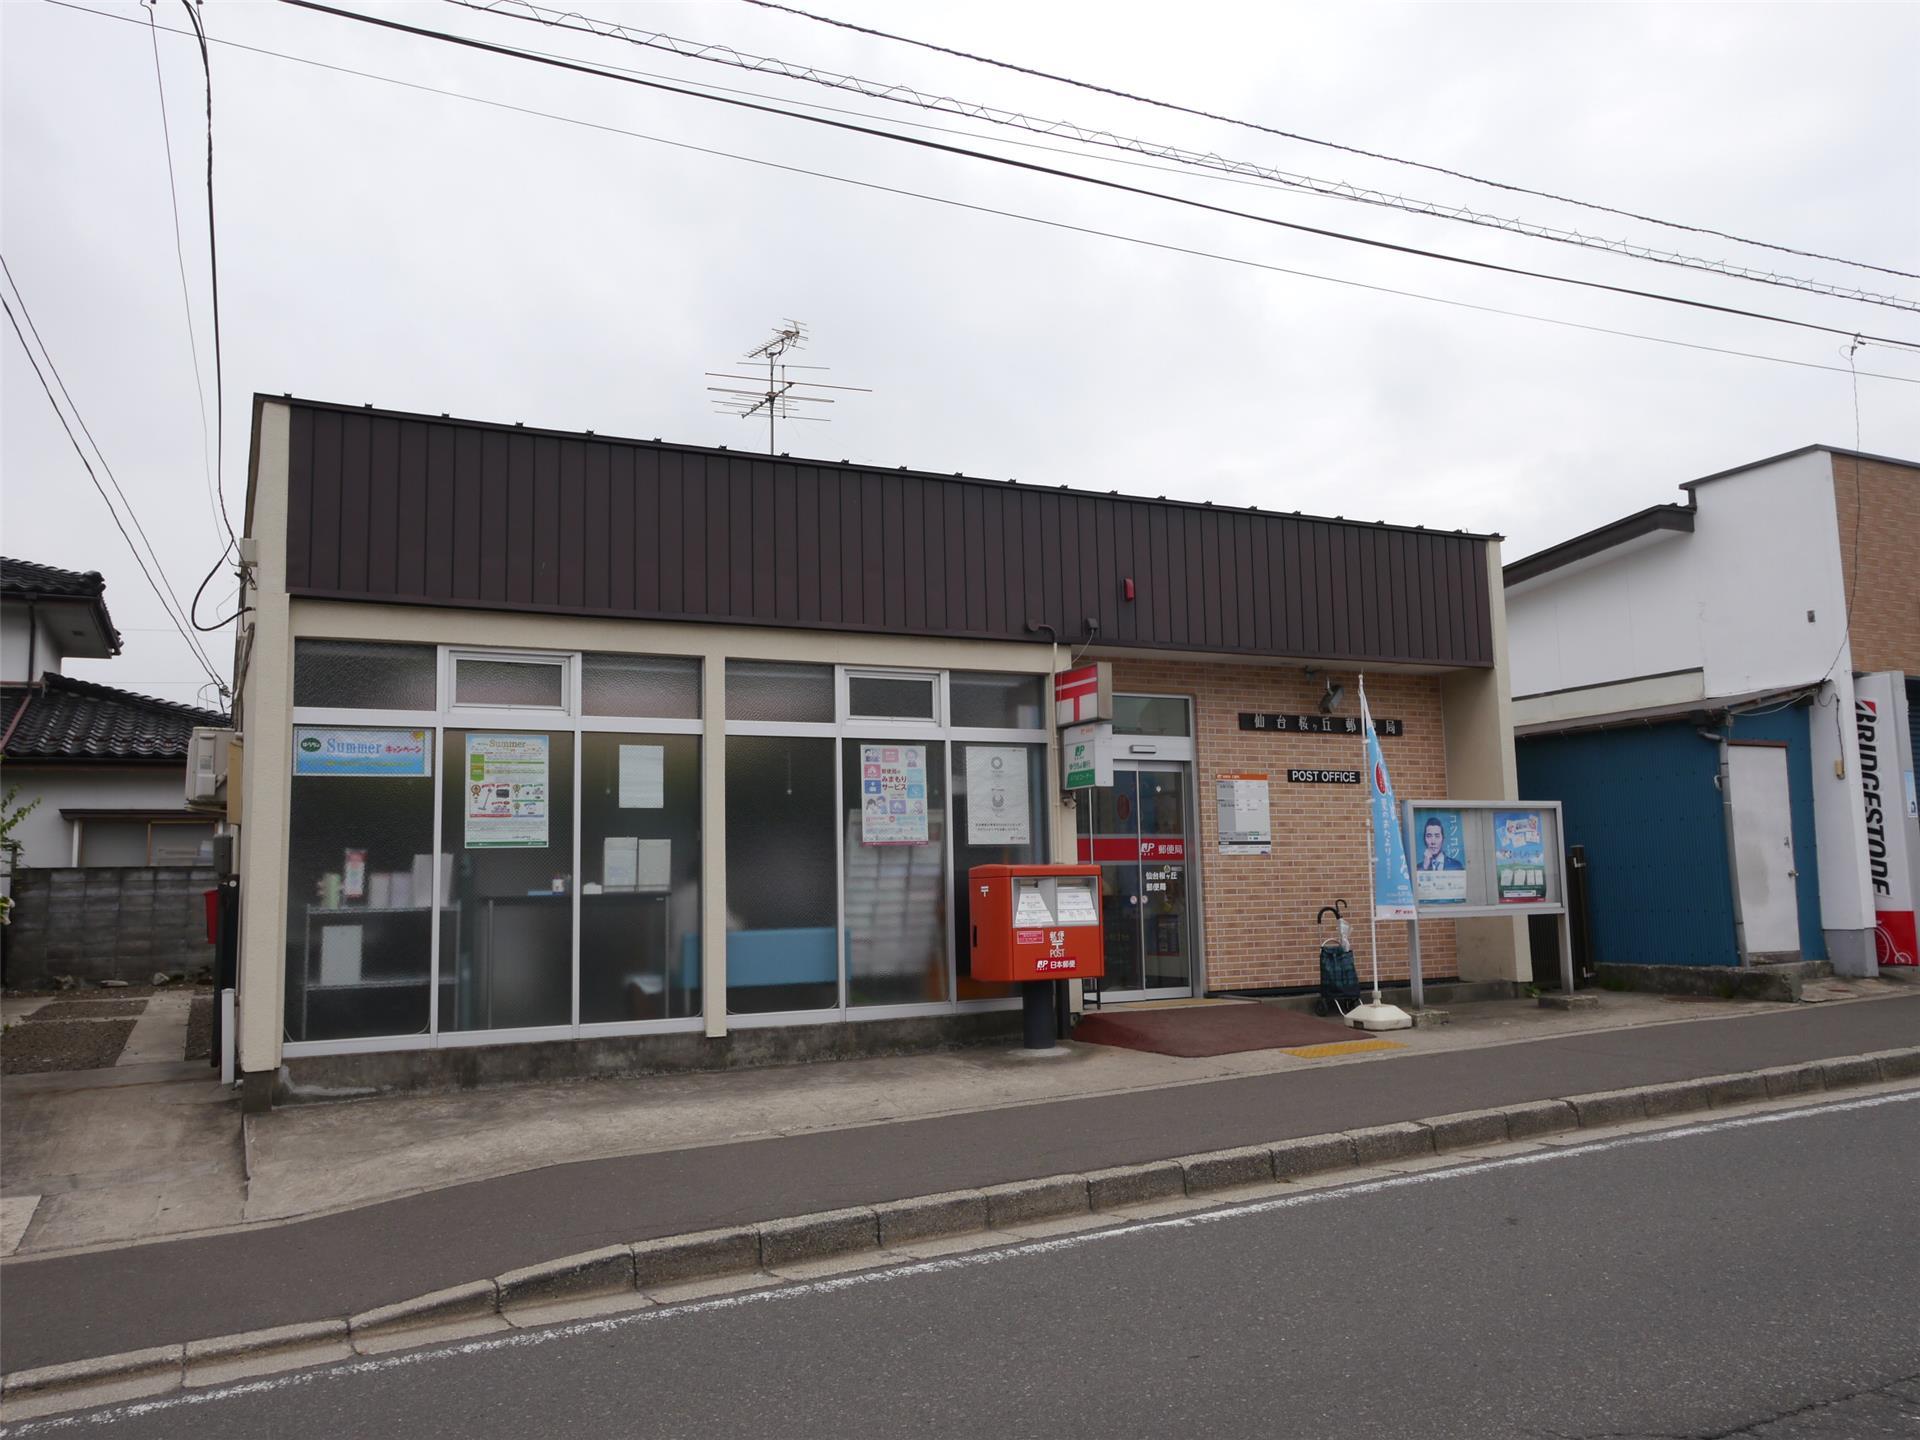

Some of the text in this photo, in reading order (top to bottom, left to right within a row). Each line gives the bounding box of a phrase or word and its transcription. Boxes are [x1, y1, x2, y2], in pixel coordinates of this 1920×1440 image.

[1254, 714, 1396, 734] 仙台桜ヶ丘郵局
[326, 738, 382, 753] Summer
[489, 739, 526, 748] Summer
[1292, 770, 1356, 783] POST OFFICE
[881, 783, 907, 791] サービス
[1158, 844, 1183, 854] 郵便局
[1049, 931, 1065, 941] 郵便
[1050, 949, 1065, 958] POST
[1050, 960, 1076, 969] 日本郵便
